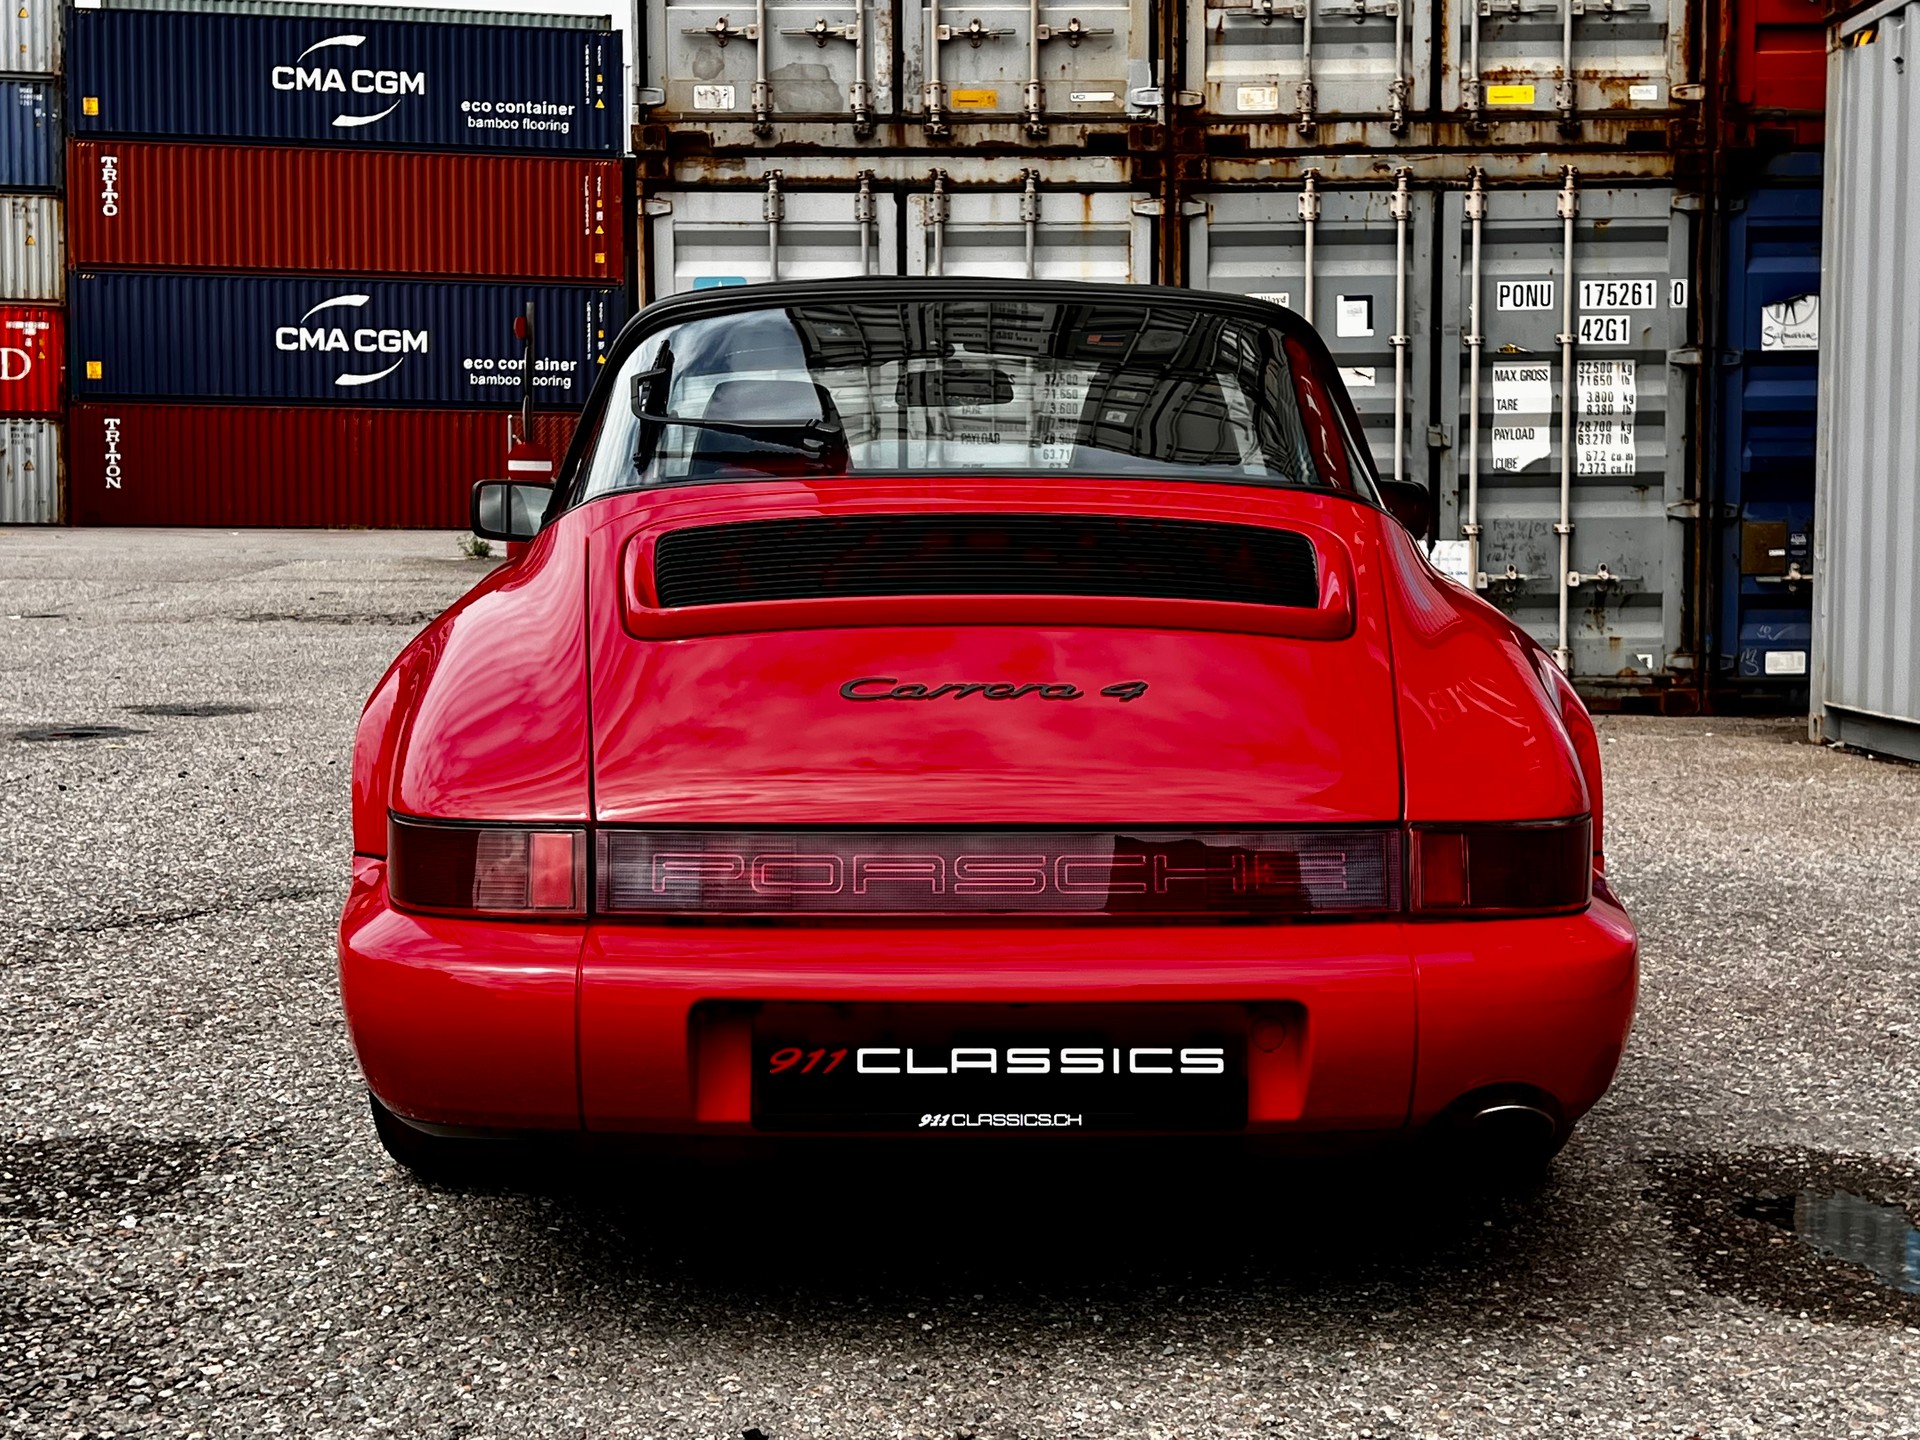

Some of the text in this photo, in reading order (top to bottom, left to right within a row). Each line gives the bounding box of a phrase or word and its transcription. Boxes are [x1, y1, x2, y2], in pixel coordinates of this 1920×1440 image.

[272, 66, 425, 95] CMA CGM
[461, 101, 575, 116] eco container
[467, 115, 569, 134] bamboo flooring
[101, 156, 118, 216] TRITO
[1500, 284, 1552, 307] PONU
[1584, 283, 1652, 306] 175261
[1581, 318, 1628, 341] 42G1
[275, 327, 428, 353] CMA CGM
[463, 357, 577, 371] eco conainer
[1621, 362, 1633, 376] kg
[470, 373, 571, 389] bamboo ooring
[1621, 375, 1630, 386] lb
[1496, 399, 1518, 411] TARE
[1623, 391, 1634, 405] kg
[1622, 404, 1632, 416] lb
[1494, 428, 1535, 440] PAYLOAD
[1621, 420, 1632, 435] kg
[1620, 433, 1630, 445] lb
[104, 418, 121, 489] TRITON
[1495, 457, 1518, 469] CUBE
[840, 676, 1150, 702] Carrera 4
[651, 852, 1347, 895] PORSCHE
